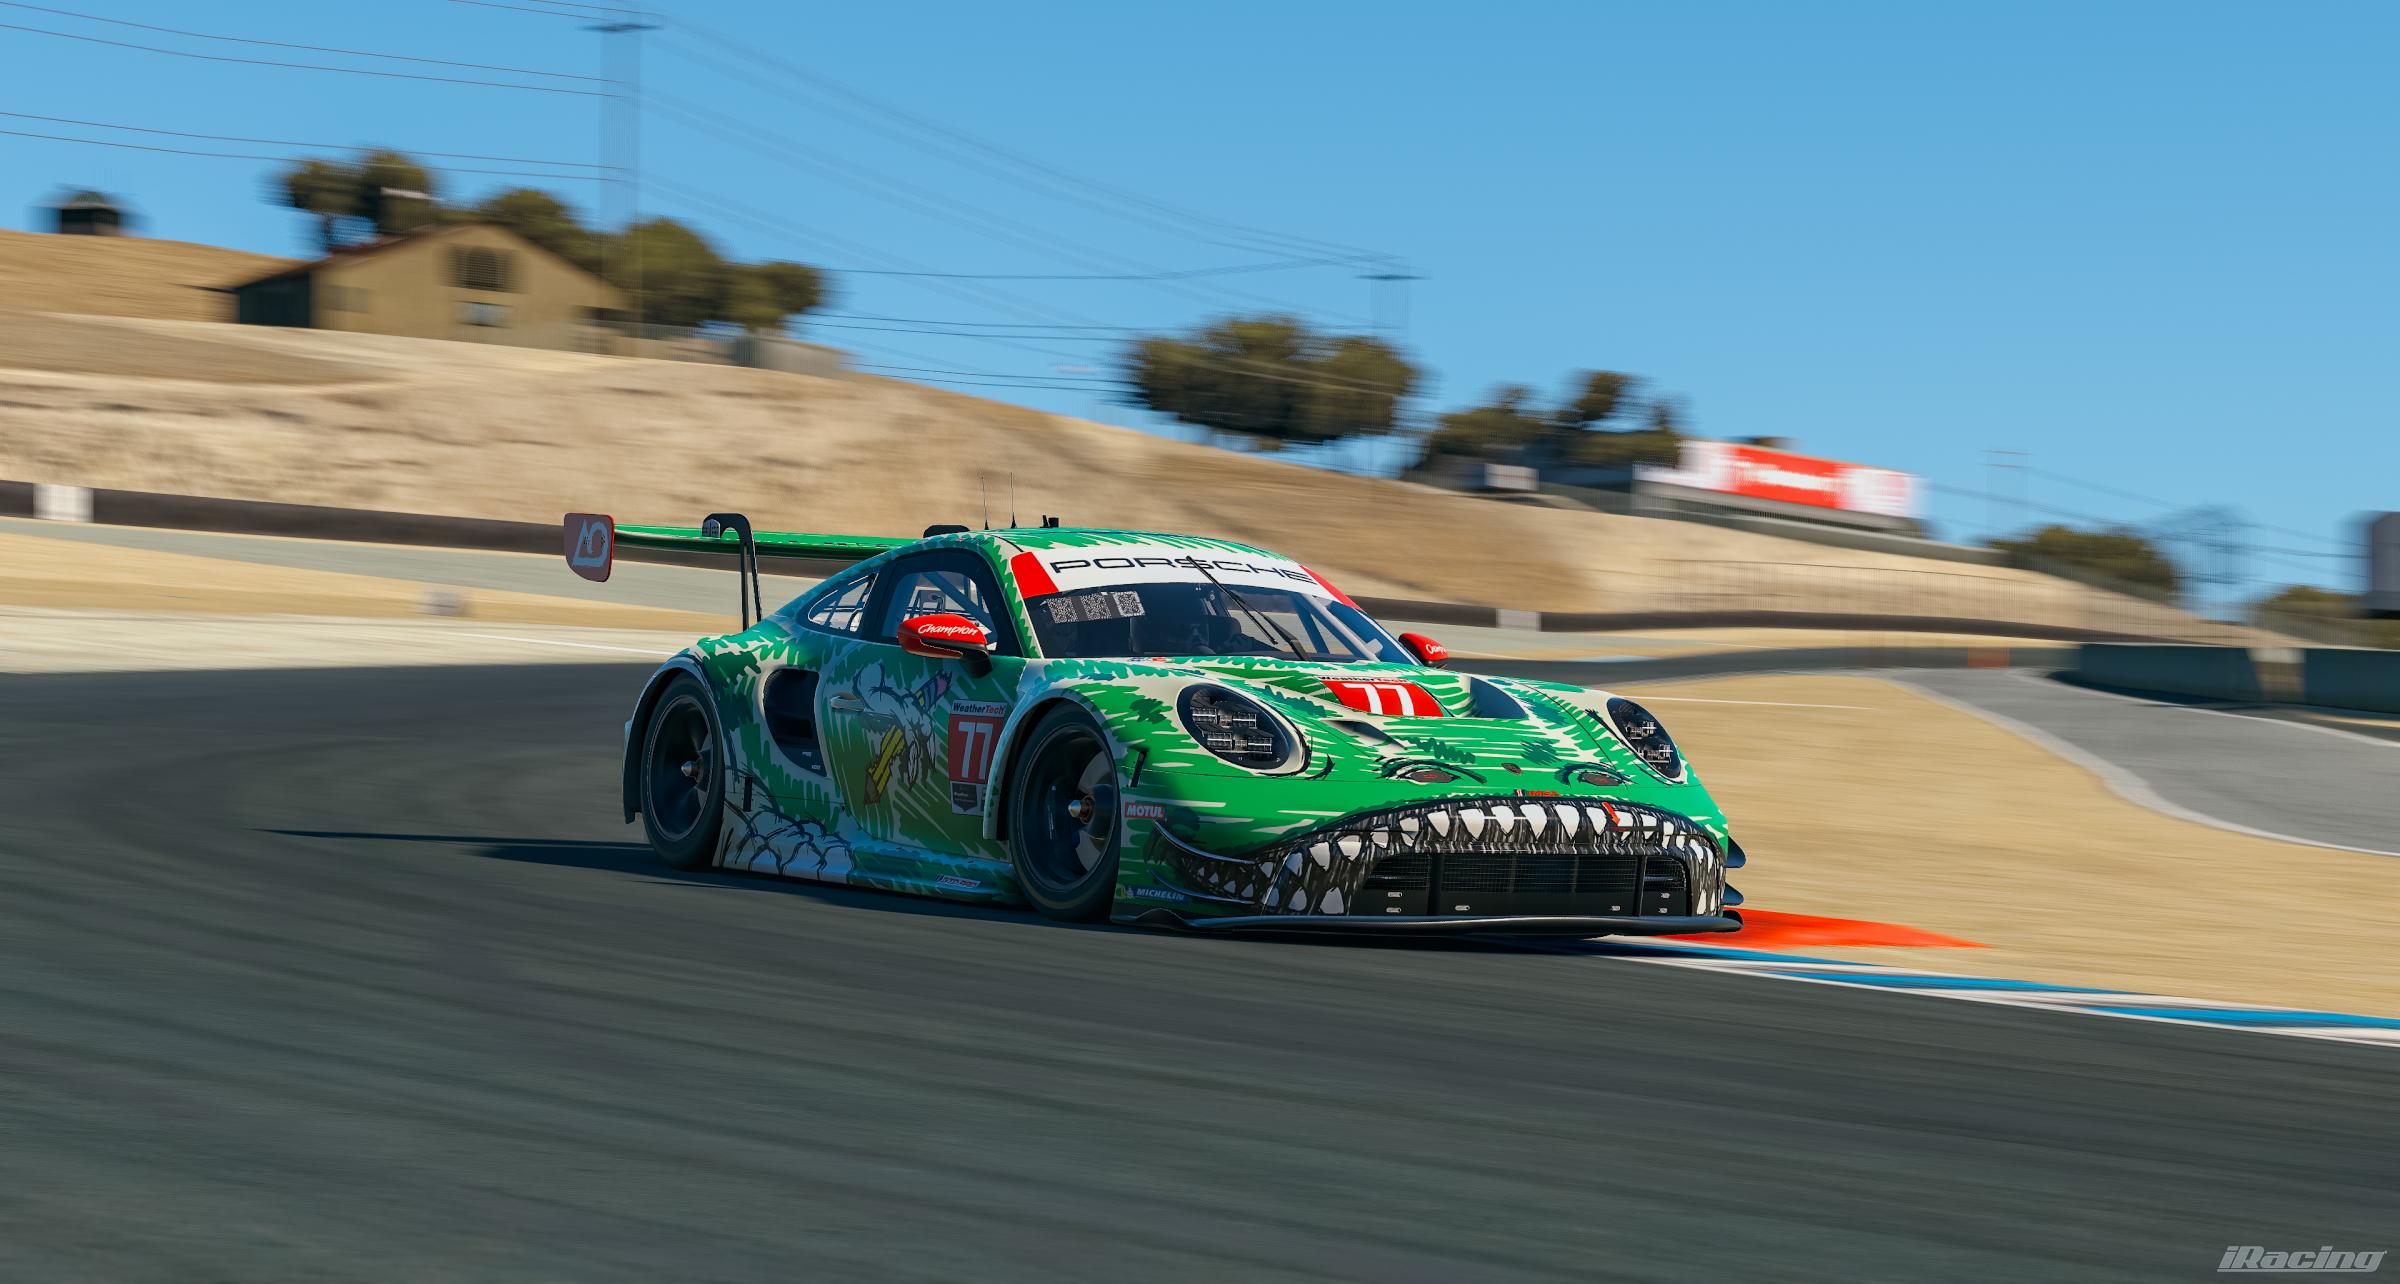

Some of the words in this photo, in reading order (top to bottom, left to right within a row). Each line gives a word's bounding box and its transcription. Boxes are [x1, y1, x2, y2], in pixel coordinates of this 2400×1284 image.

[1050, 557, 1317, 584] PORSCHE
[918, 623, 979, 637] Champion
[1318, 675, 1408, 683] WeatherTech
[1343, 682, 1415, 717] 77
[953, 701, 1005, 715] WeatherTech
[958, 721, 994, 780] 77
[1126, 804, 1163, 817] MOTUL
[1136, 888, 1185, 901] MICHELIN
